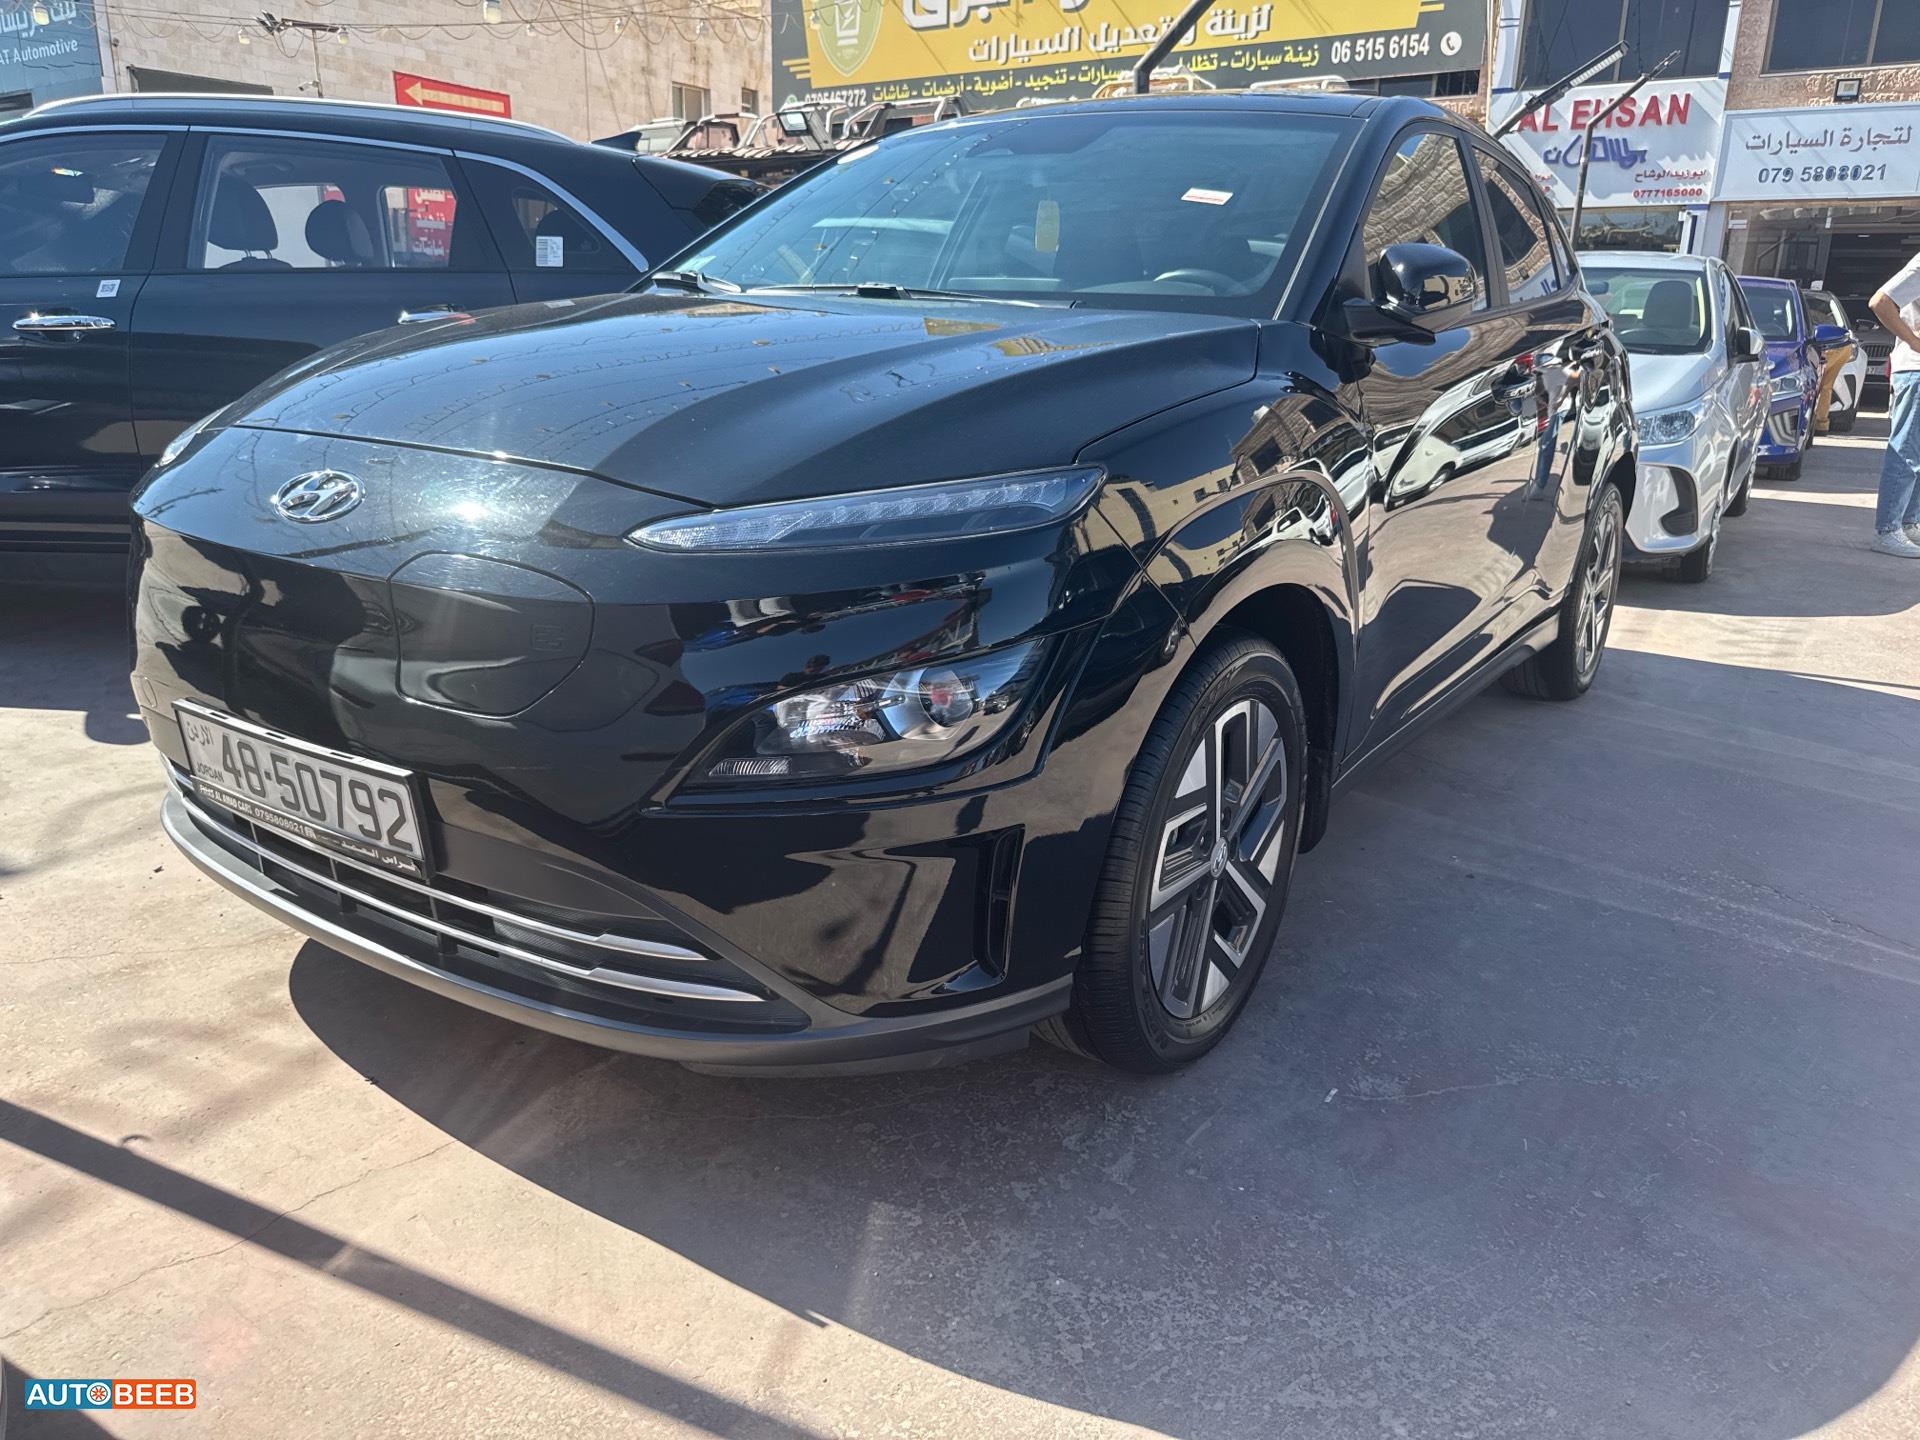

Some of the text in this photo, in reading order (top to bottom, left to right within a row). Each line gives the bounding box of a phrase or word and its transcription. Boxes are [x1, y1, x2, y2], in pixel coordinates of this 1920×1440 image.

[1205, 4, 1272, 39] لزينة
[14, 39, 79, 63] Automotive
[969, 26, 1082, 64] السيارات
[1283, 45, 1319, 67] زينة
[1331, 33, 1429, 64] 06 515 6154
[1230, 49, 1281, 71] سيارات
[872, 83, 910, 101] شاشات
[1745, 125, 1912, 155] لتجارة السيارات
[1758, 167, 1794, 183] 079
[222, 733, 413, 852] 48-50792
